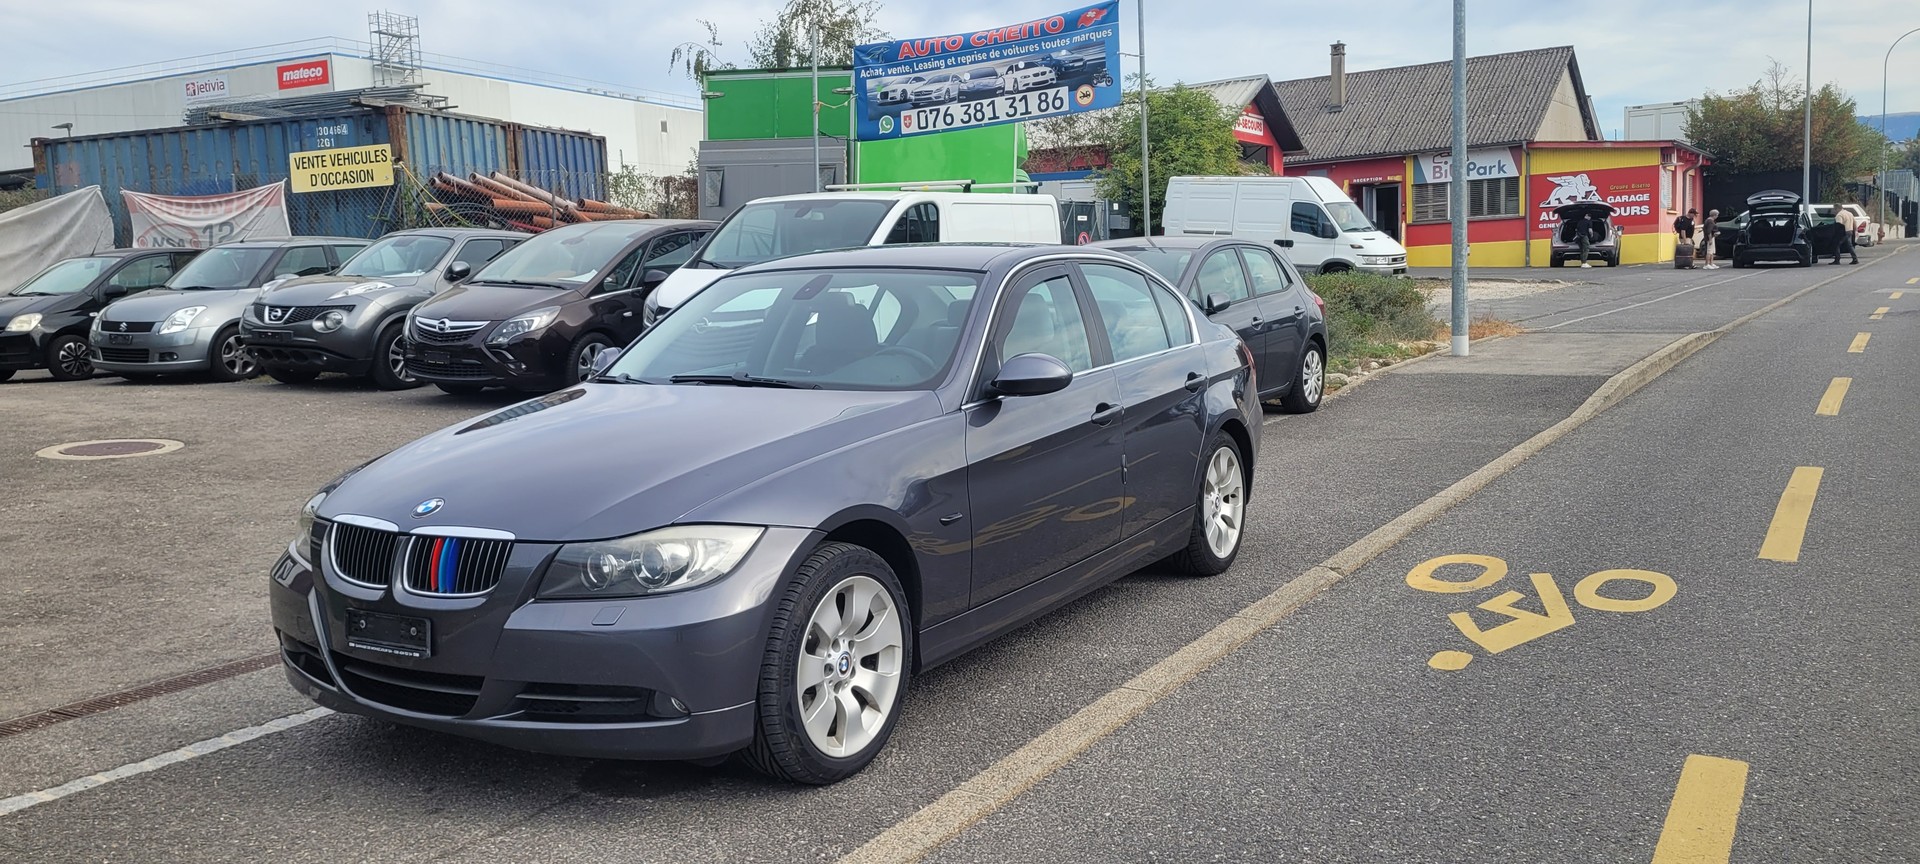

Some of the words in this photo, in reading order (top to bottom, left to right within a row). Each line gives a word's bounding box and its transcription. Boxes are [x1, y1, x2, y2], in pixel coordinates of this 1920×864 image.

[898, 36, 963, 60] AUTO
[970, 15, 1064, 47] CHEITO
[860, 67, 885, 78] Achat,
[887, 65, 912, 75] vente,
[914, 58, 945, 71] Leasing
[947, 57, 956, 65] et
[958, 50, 987, 64] reprise
[990, 49, 1000, 58] de
[1002, 43, 1040, 56] voitures
[1041, 37, 1070, 49] toutes
[1072, 28, 1113, 43] marques
[282, 67, 323, 82] mateco
[196, 78, 225, 95] jetivia
[917, 107, 955, 130] 076
[960, 99, 1000, 124] 381
[1005, 94, 1032, 118] 31
[1037, 89, 1064, 113] 86
[294, 154, 327, 170] VENTE
[329, 148, 388, 167] VEHICULES
[310, 168, 374, 187] D'OCCASION
[1607, 193, 1650, 204] GARAGE
[784, 620, 802, 688] UNIROYAL
